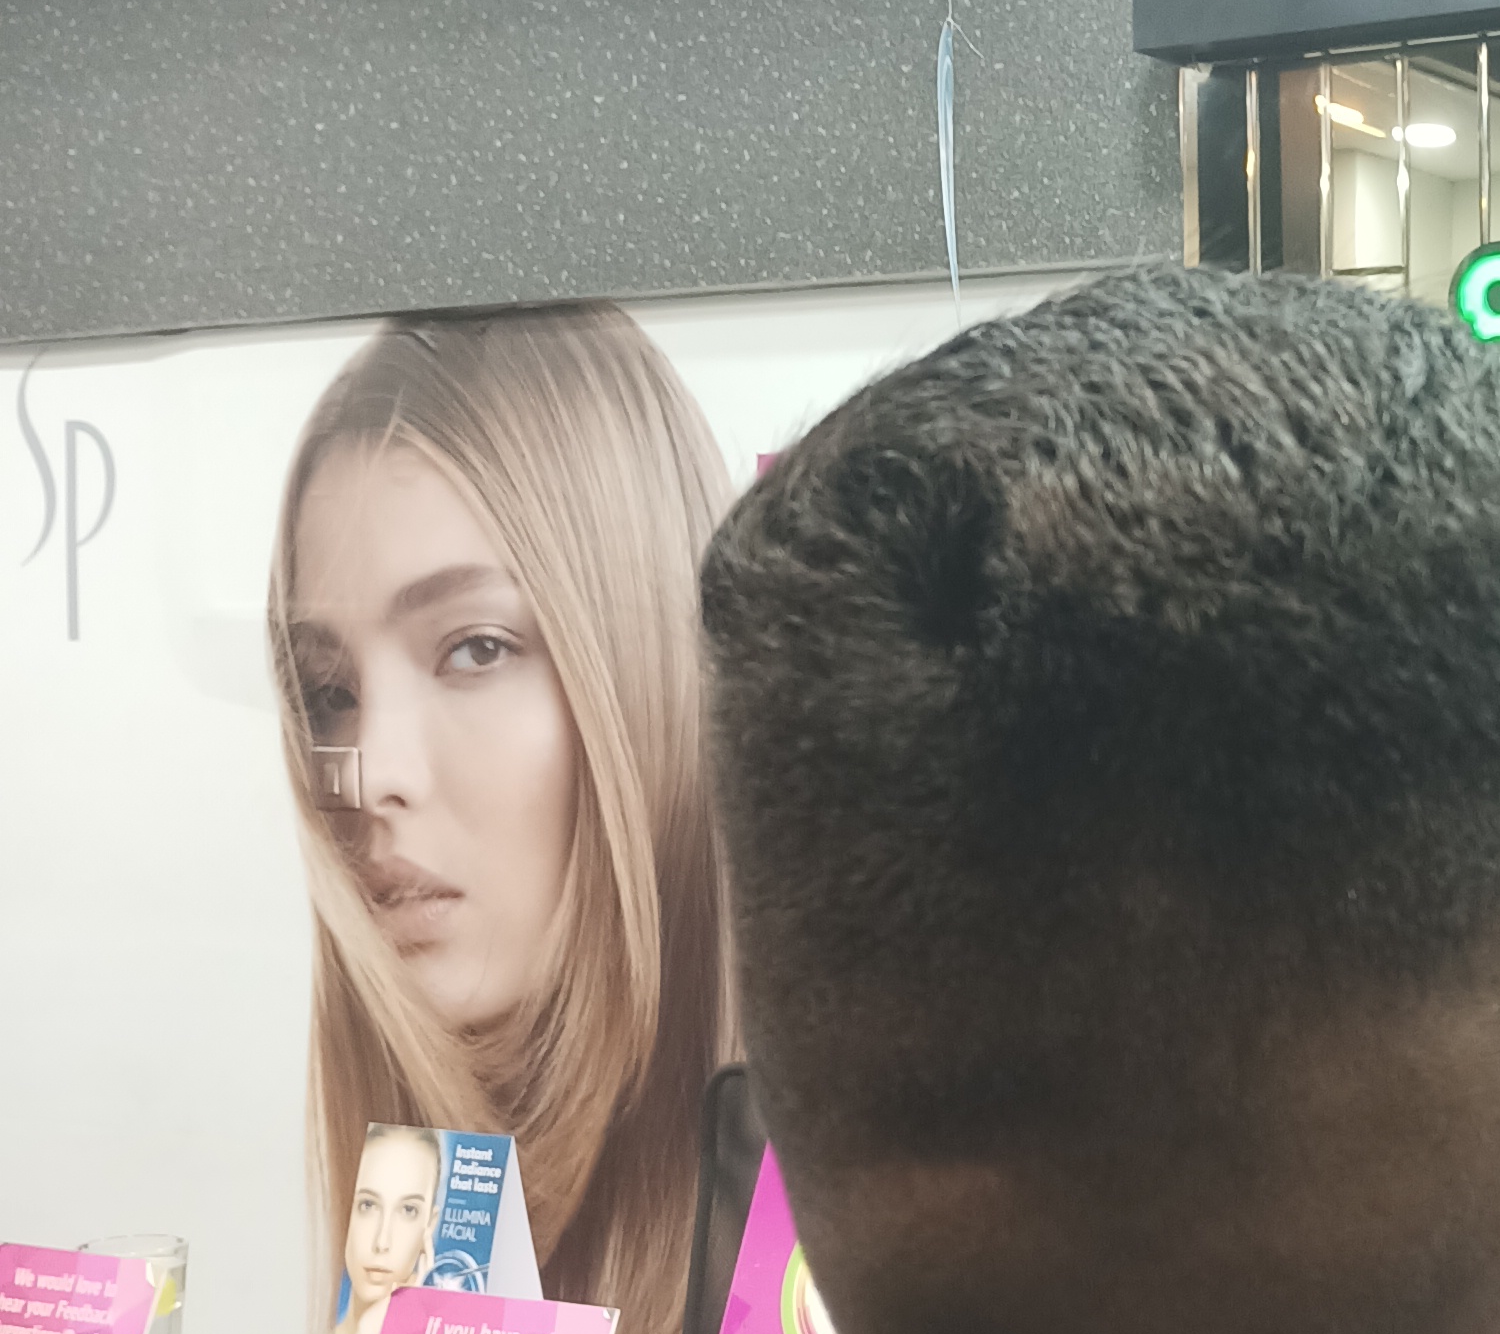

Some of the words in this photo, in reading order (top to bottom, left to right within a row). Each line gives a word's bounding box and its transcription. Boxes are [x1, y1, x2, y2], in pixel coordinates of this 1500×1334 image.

[456, 1144, 493, 1161] Instant
[453, 1160, 502, 1178] Radiance
[450, 1175, 472, 1192] that
[473, 1177, 499, 1194] lasts
[441, 1223, 477, 1243] FACIAL
[14, 1267, 35, 1287] We
[36, 1273, 76, 1293] would
[75, 1275, 103, 1296] love
[24, 1300, 55, 1319] your
